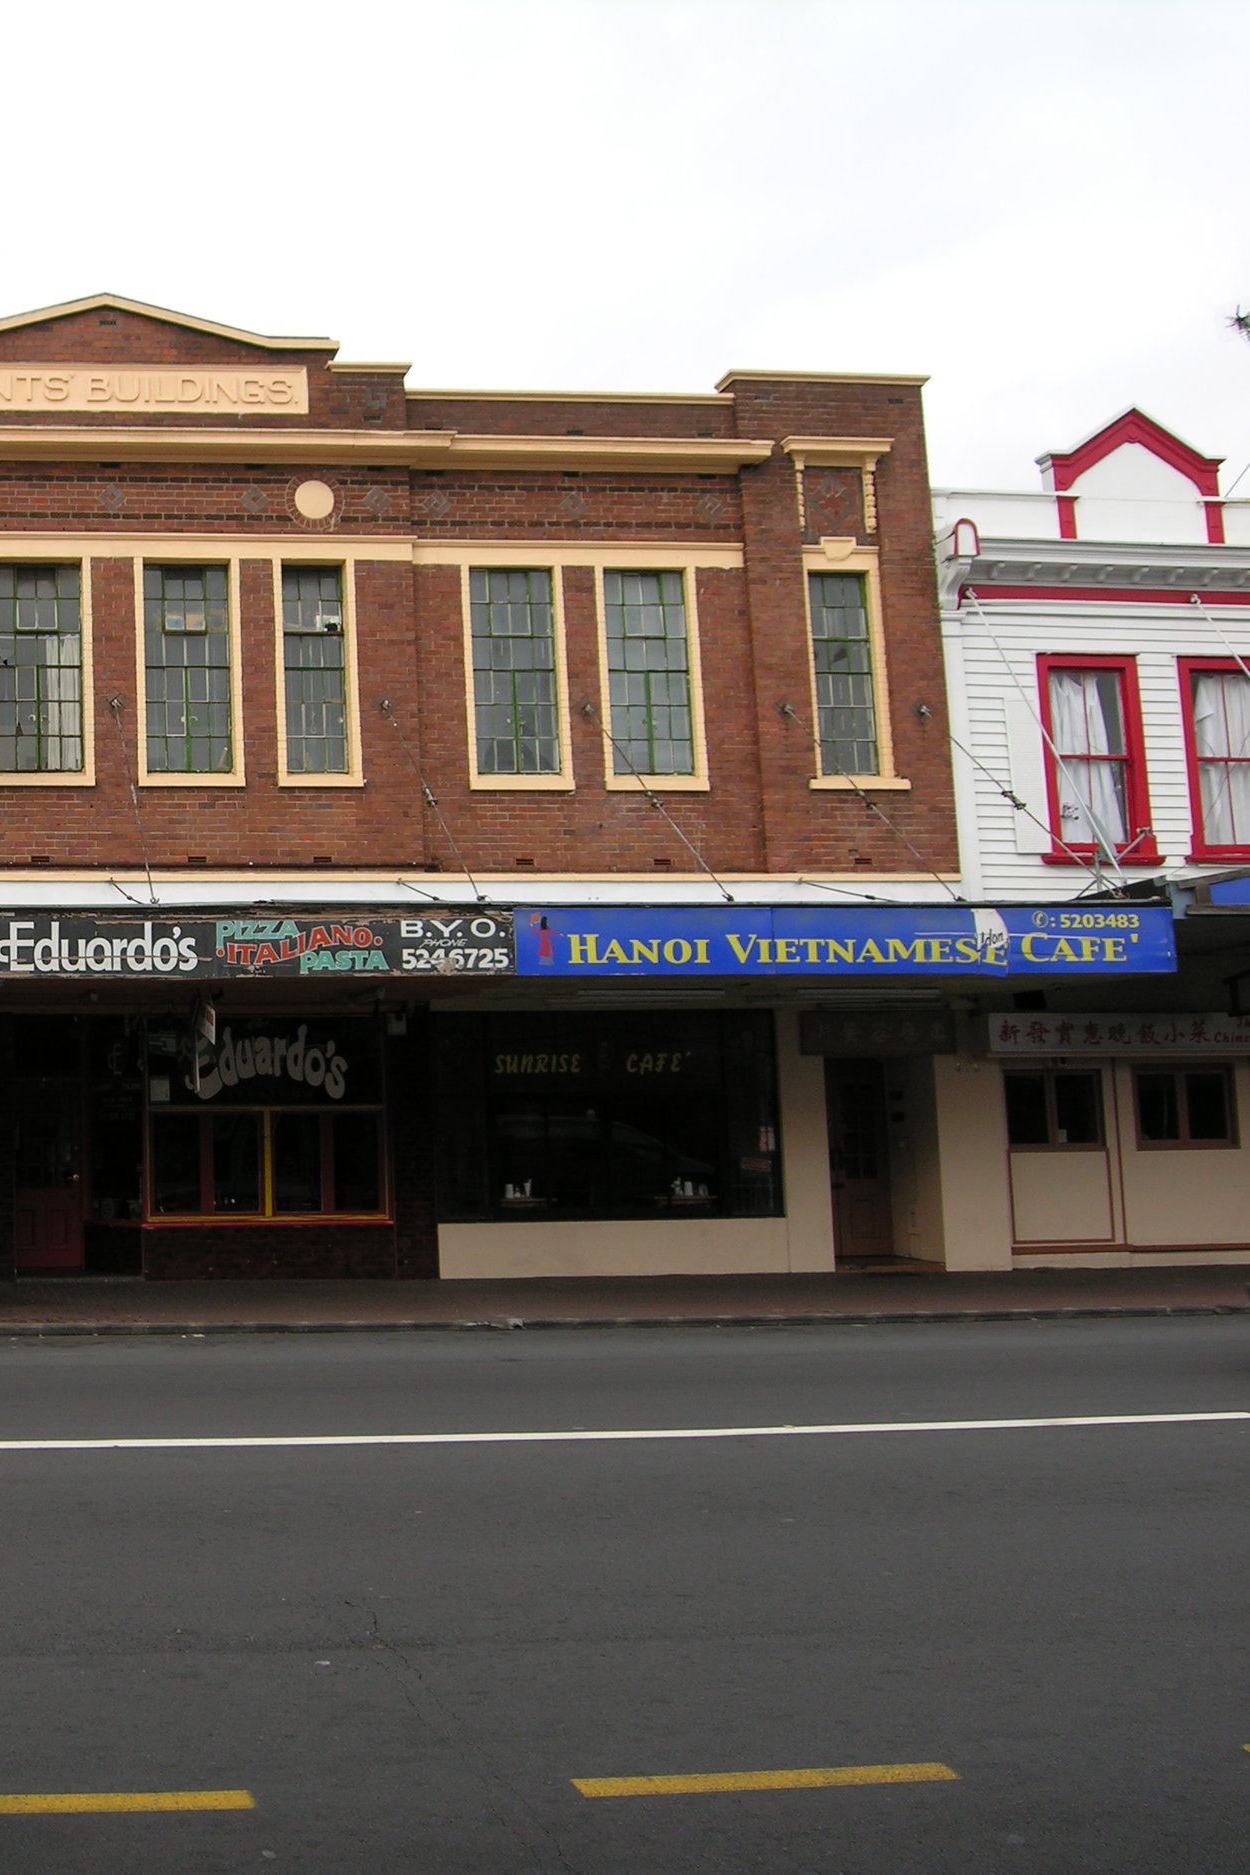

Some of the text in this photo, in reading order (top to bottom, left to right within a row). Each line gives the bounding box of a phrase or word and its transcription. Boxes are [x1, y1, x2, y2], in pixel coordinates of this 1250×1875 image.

[215, 919, 300, 949] PIZZA
[1059, 913, 1140, 929] 5203483
[419, 937, 469, 949] PHONE
[567, 933, 710, 965] HANOI
[725, 933, 1009, 966] VIETNAMESE
[299, 949, 390, 975] PASTA
[184, 1023, 350, 1100] Eduardo's
[494, 1053, 582, 1075] SUNRISE
